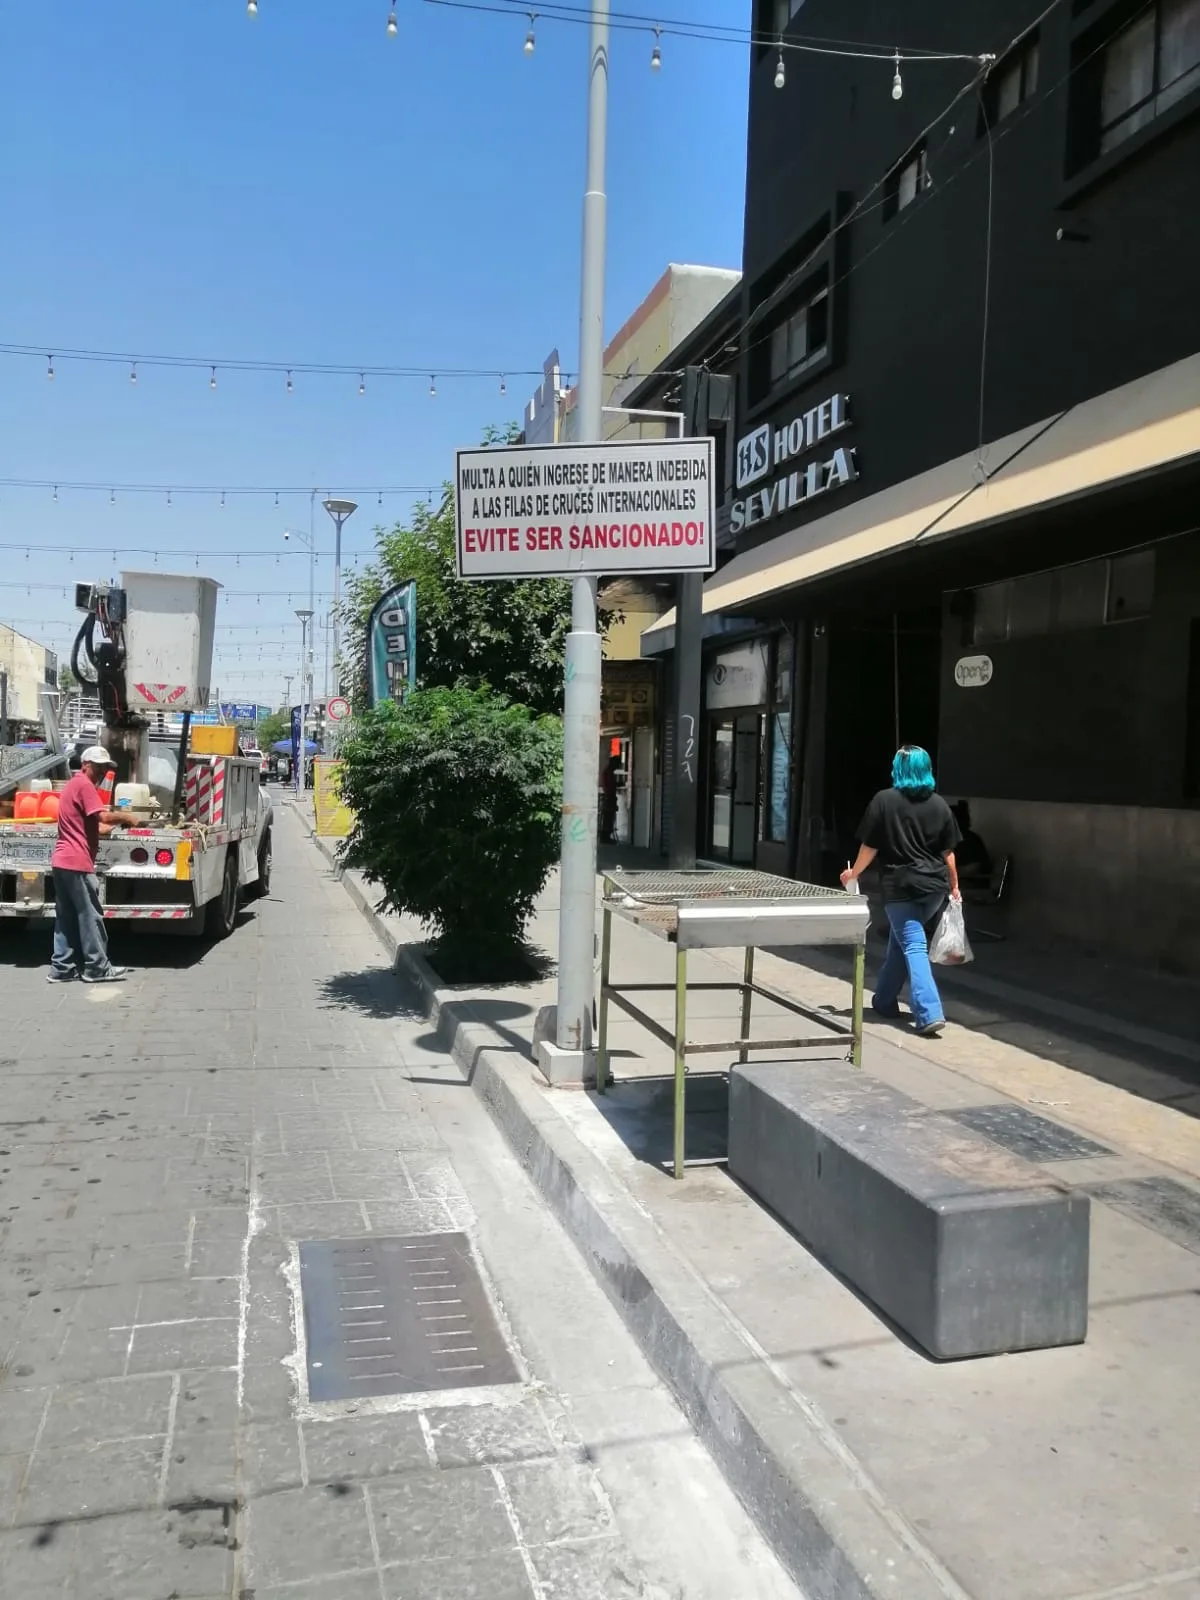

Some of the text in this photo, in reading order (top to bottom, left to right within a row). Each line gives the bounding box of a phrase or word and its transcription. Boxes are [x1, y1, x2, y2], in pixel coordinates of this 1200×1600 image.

[774, 393, 846, 465] HOTEL
[462, 459, 707, 490] MULTA A QUIÉN INGRESE DE MANERA INDEBIDA
[472, 489, 696, 519] A LAS FILAS DE CRUCES INTERNACIONALES
[729, 447, 850, 534] SEVILLA
[465, 521, 705, 552] EVITE SER SANCIONADO!
